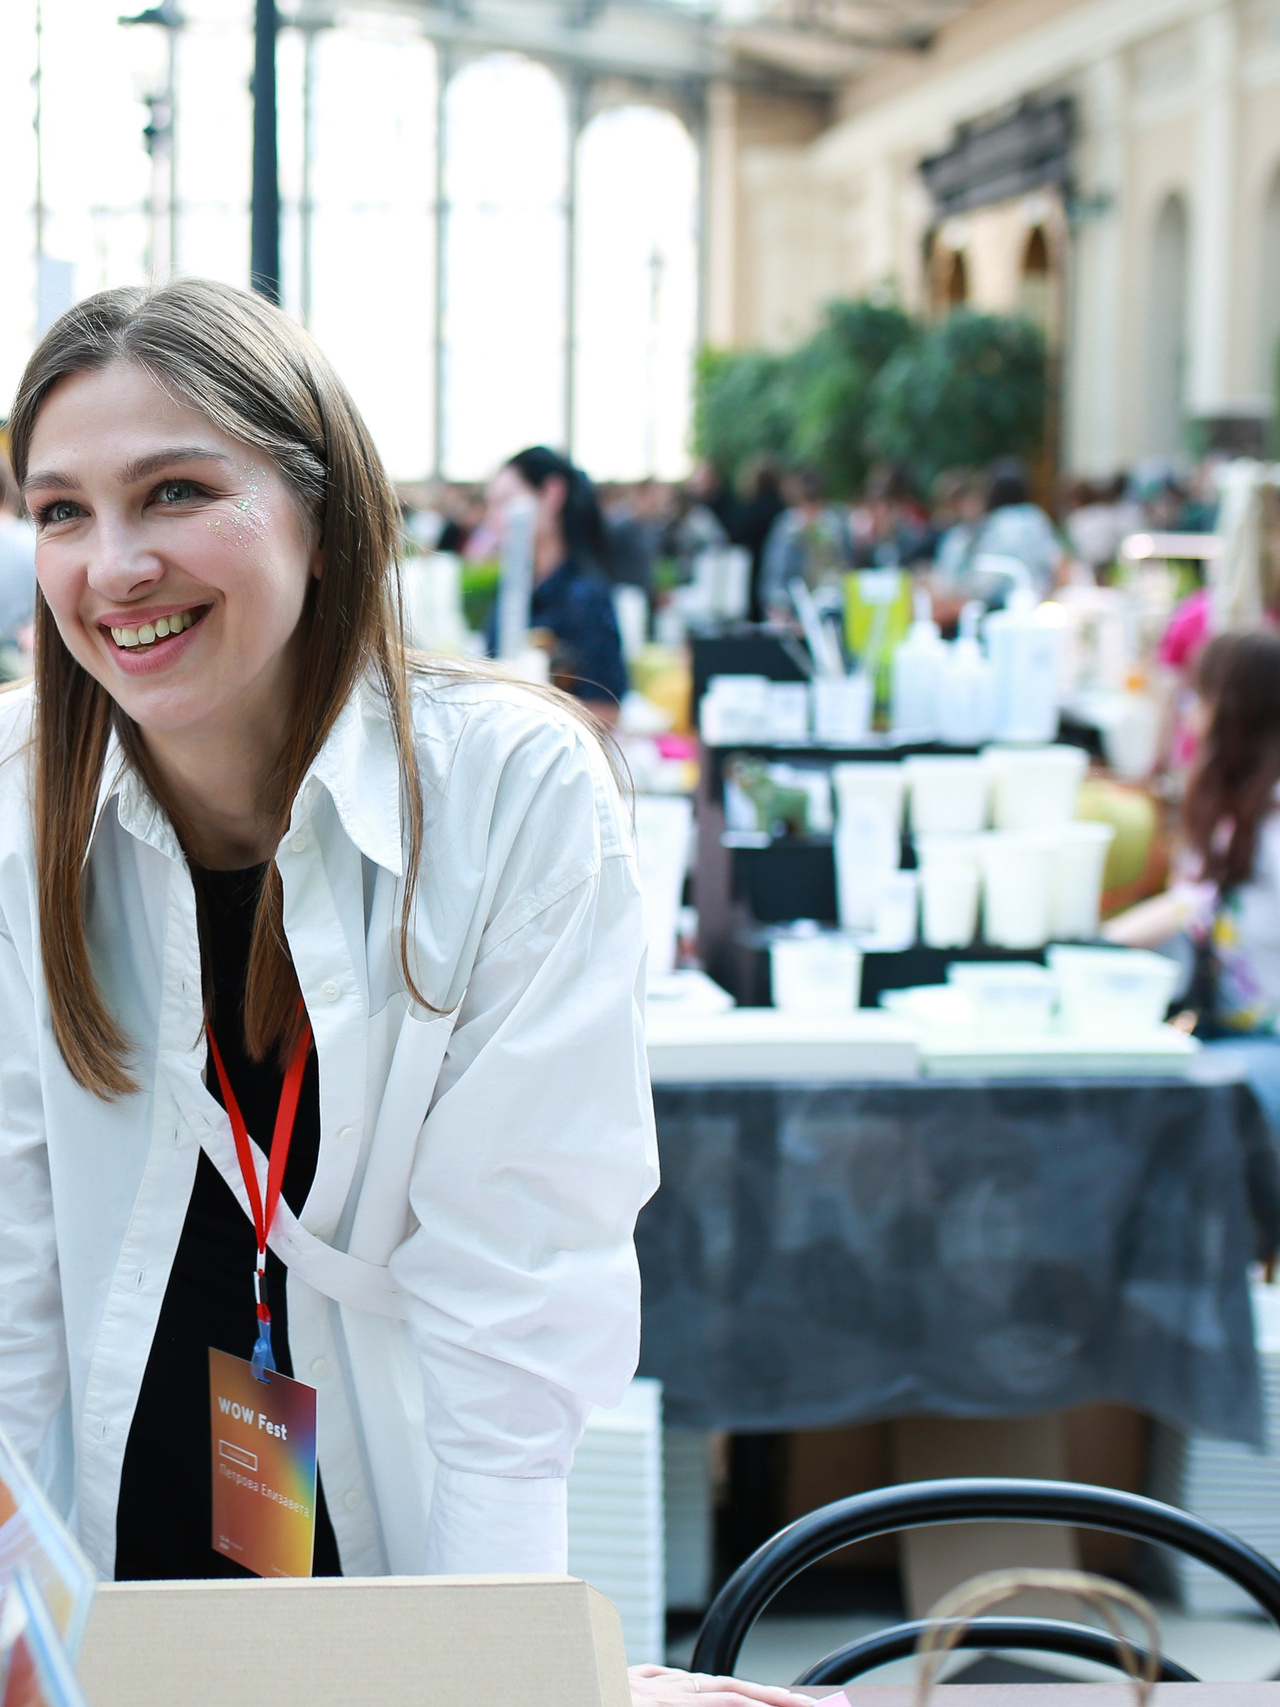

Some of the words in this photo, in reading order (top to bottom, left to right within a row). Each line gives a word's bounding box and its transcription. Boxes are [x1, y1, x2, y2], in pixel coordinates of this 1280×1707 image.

[218, 1396, 254, 1425] WOW
[258, 1413, 287, 1440] Fest
[261, 1483, 310, 1517] Елизавета
